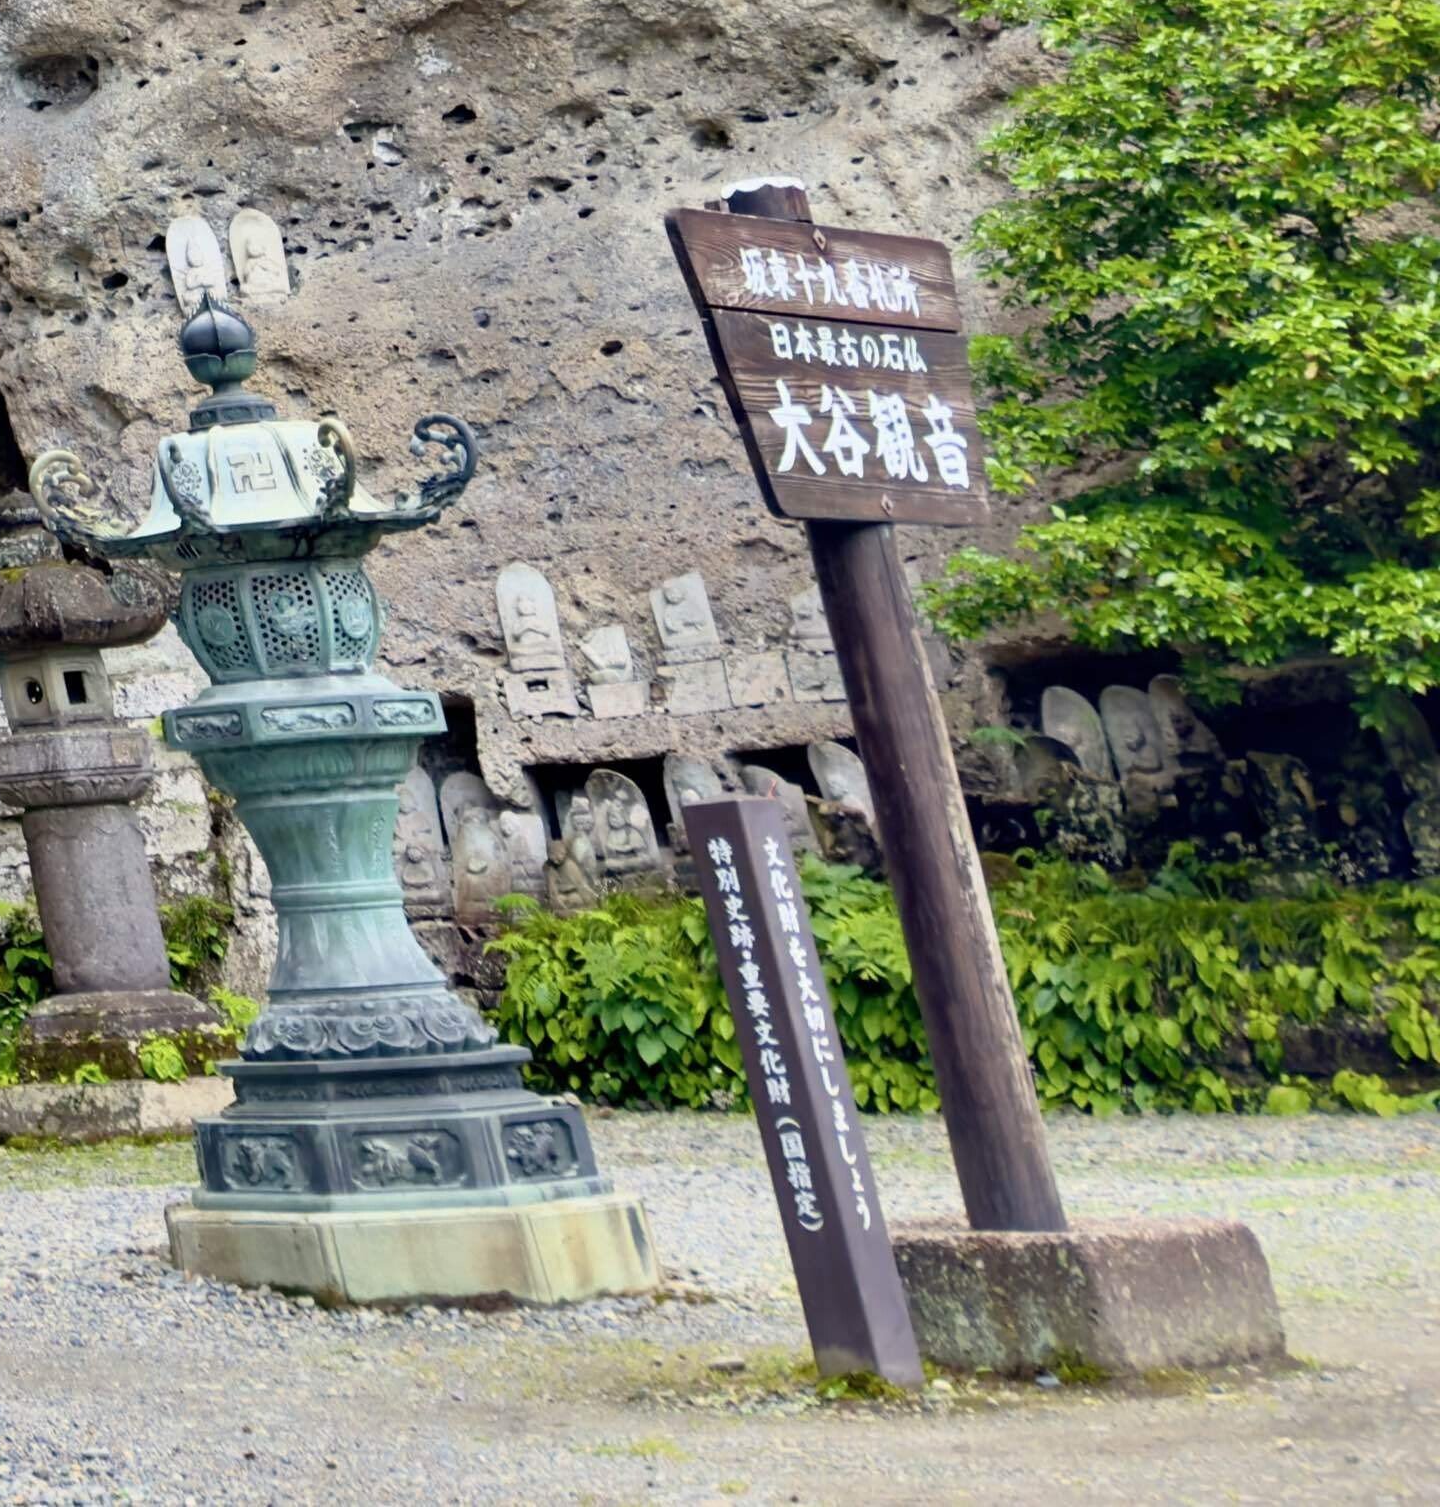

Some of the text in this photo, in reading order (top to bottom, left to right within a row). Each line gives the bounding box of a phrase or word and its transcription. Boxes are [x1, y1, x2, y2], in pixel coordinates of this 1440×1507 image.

[740, 248, 920, 318] 坂東十九番札所
[769, 322, 928, 372] 日本最古の石仏
[767, 379, 970, 488] 大谷観音
[763, 835, 870, 1232] 文化財を大切にしましょう
